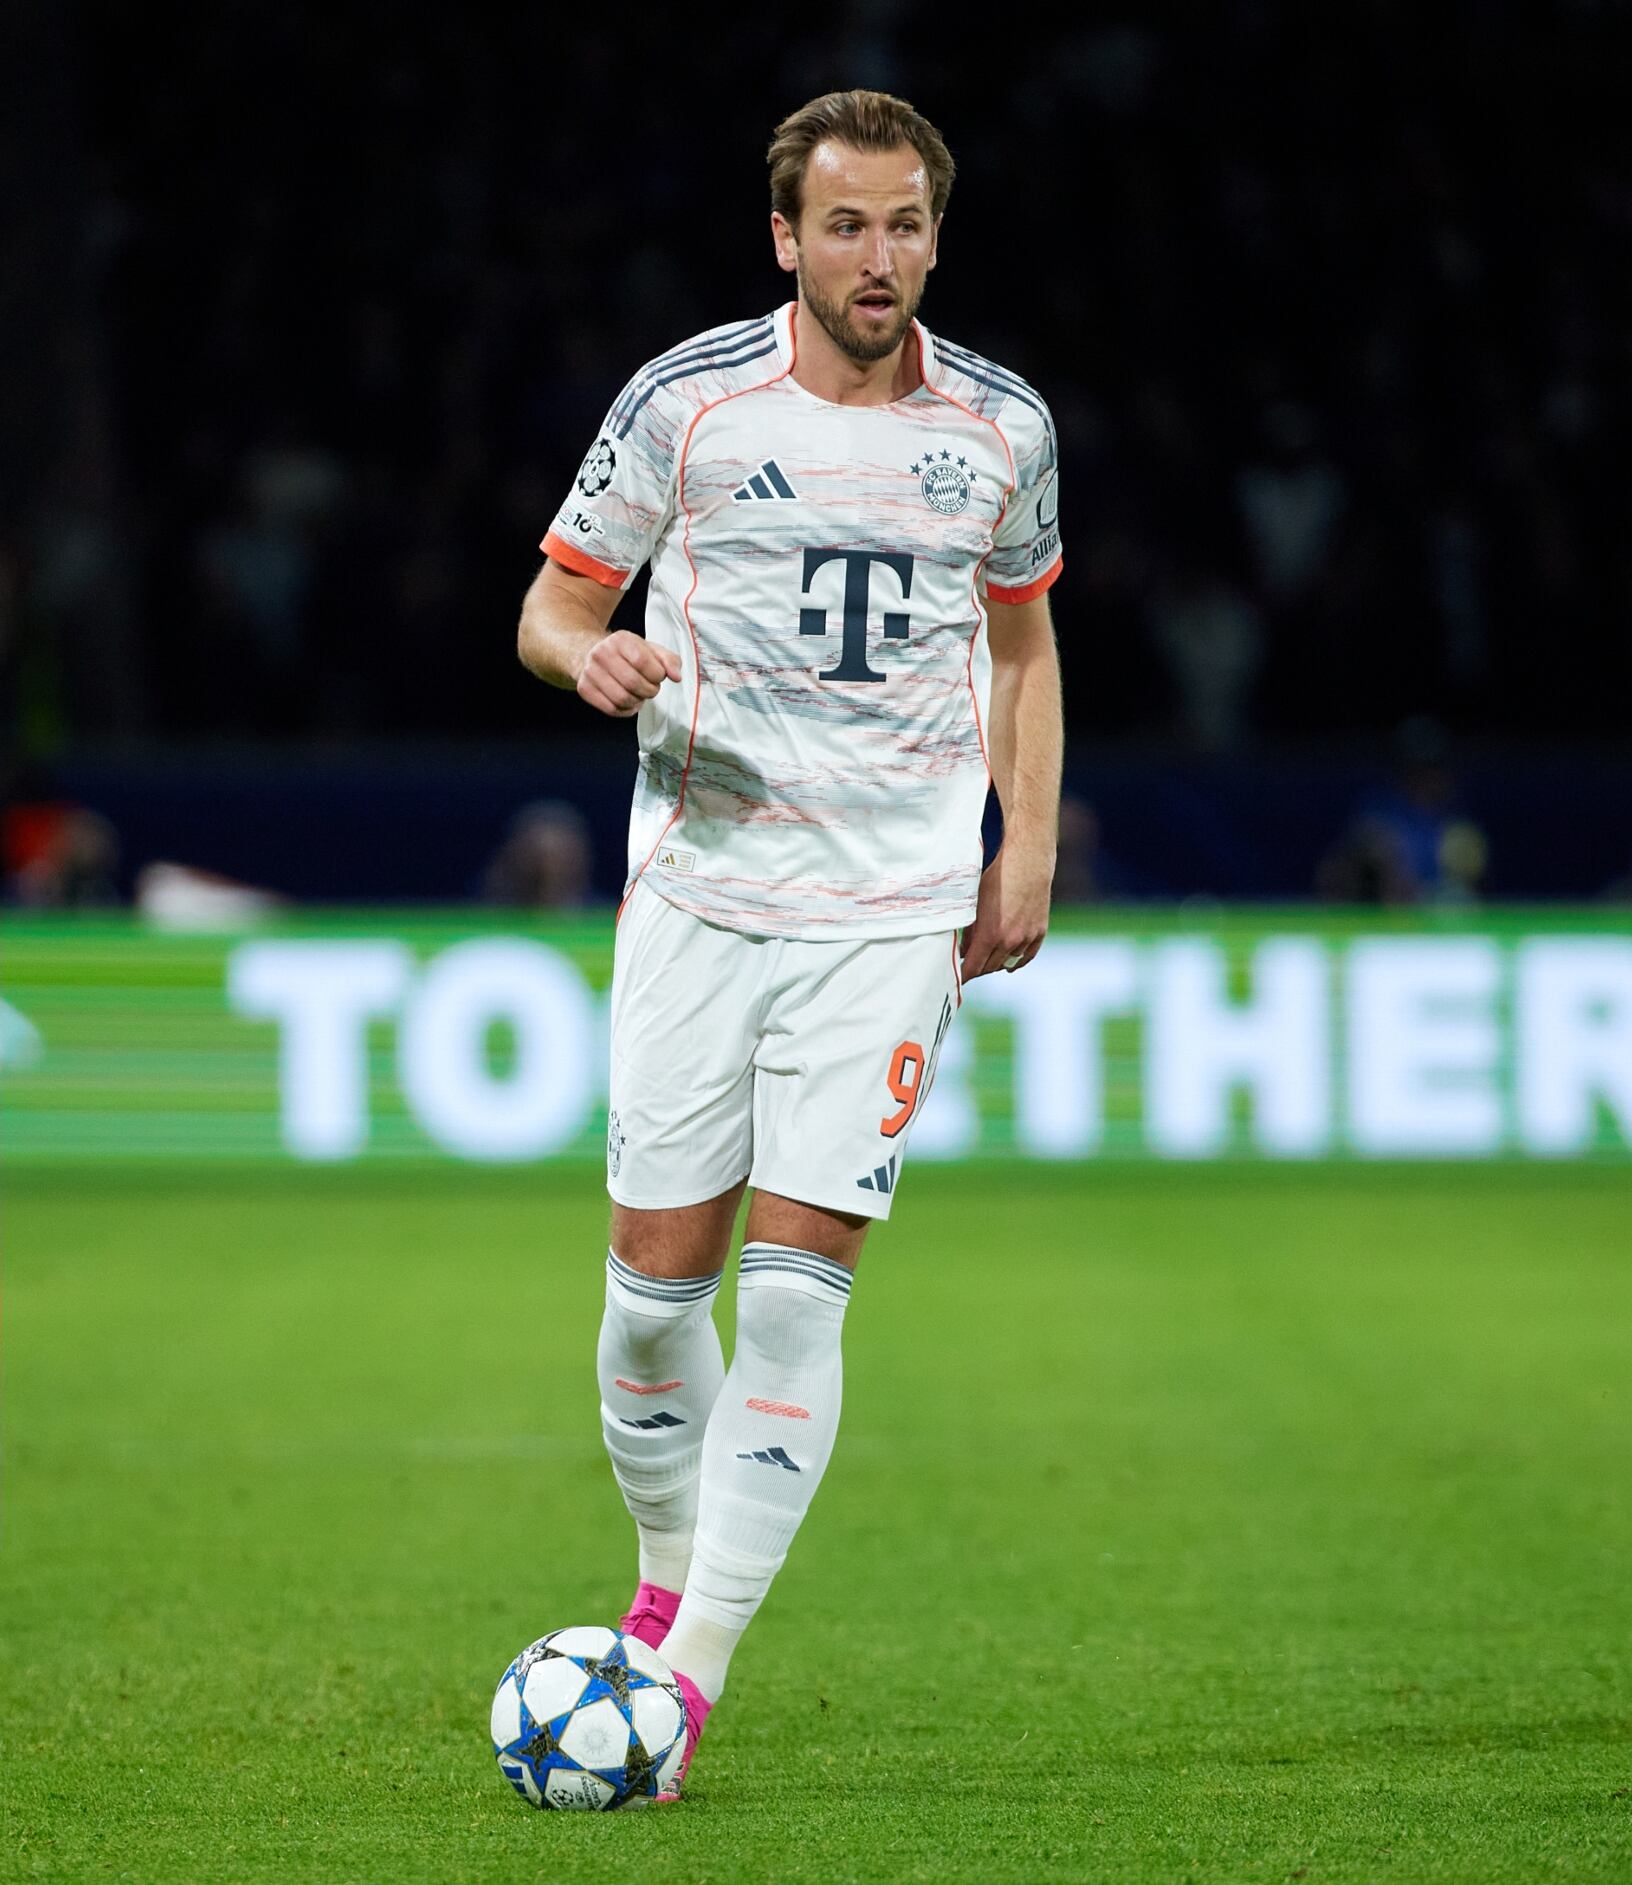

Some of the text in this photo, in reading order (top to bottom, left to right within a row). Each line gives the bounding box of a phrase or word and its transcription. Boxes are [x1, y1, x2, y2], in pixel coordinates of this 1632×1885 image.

[936, 467, 966, 489] BAYERN
[799, 547, 914, 682] T
[228, 935, 1632, 1165] TOTHER
[880, 1040, 925, 1138] 9
